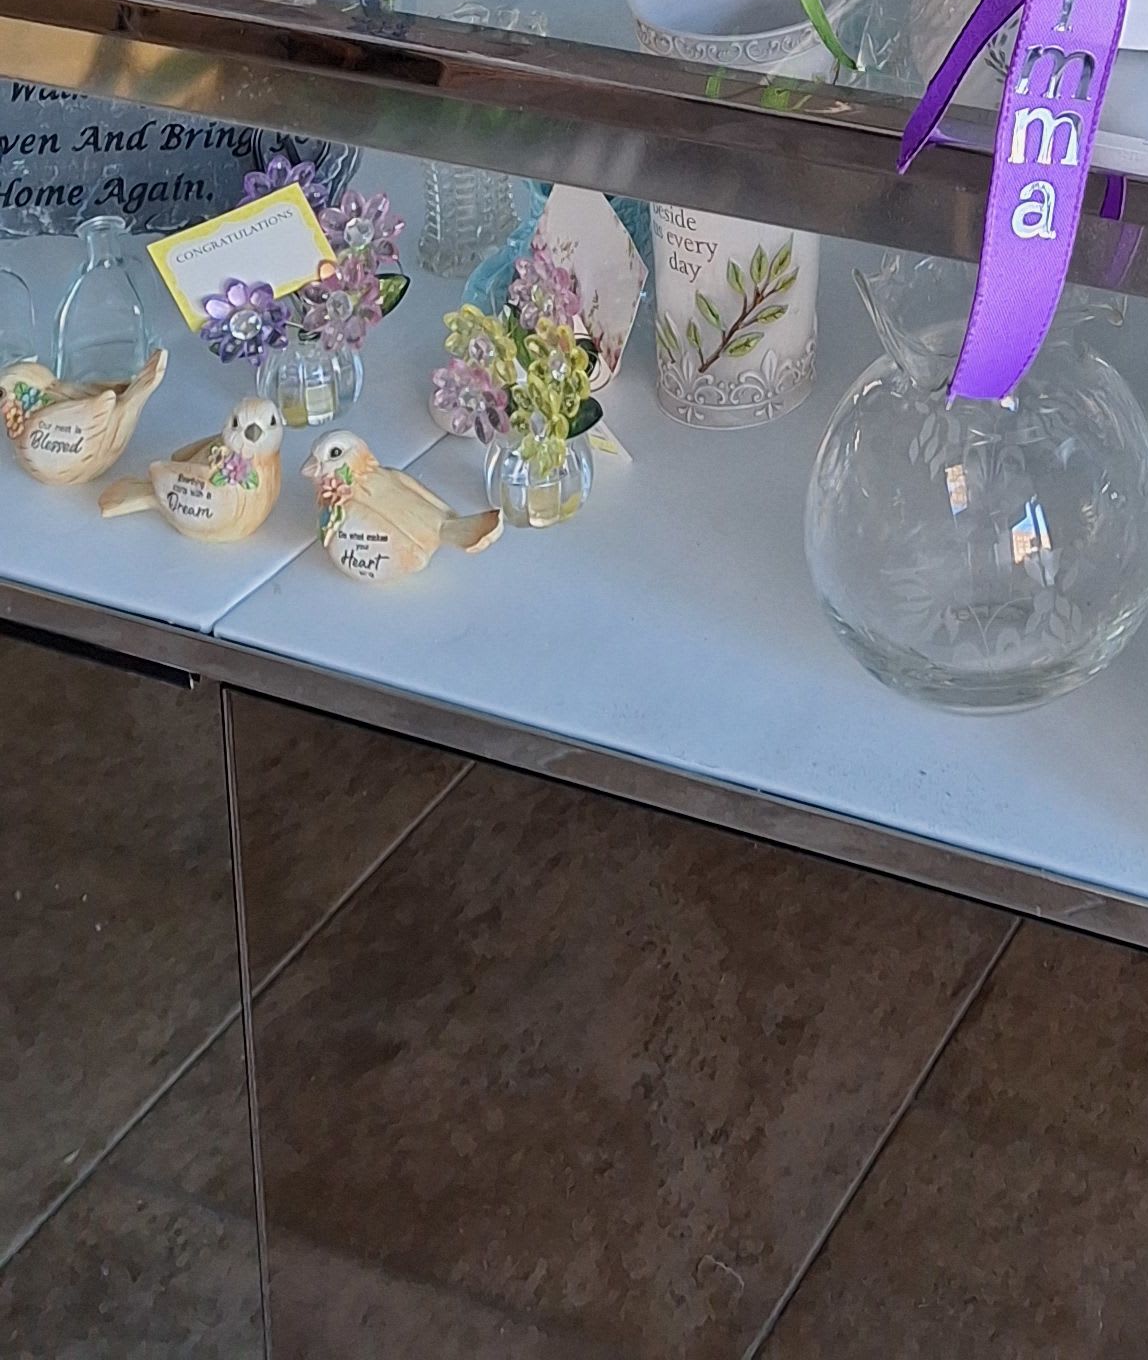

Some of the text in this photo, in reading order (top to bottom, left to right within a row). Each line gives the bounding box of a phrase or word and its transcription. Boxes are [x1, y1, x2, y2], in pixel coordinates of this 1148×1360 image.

[73, 121, 157, 154] And
[159, 121, 253, 157] Bring
[94, 172, 214, 214] Again.
[175, 208, 295, 264] CONGRATULATIONS
[666, 231, 719, 263] every
[668, 251, 703, 284] day
[29, 429, 85, 454] Blessed
[166, 491, 214, 519] Dream
[340, 548, 391, 572] Heart
